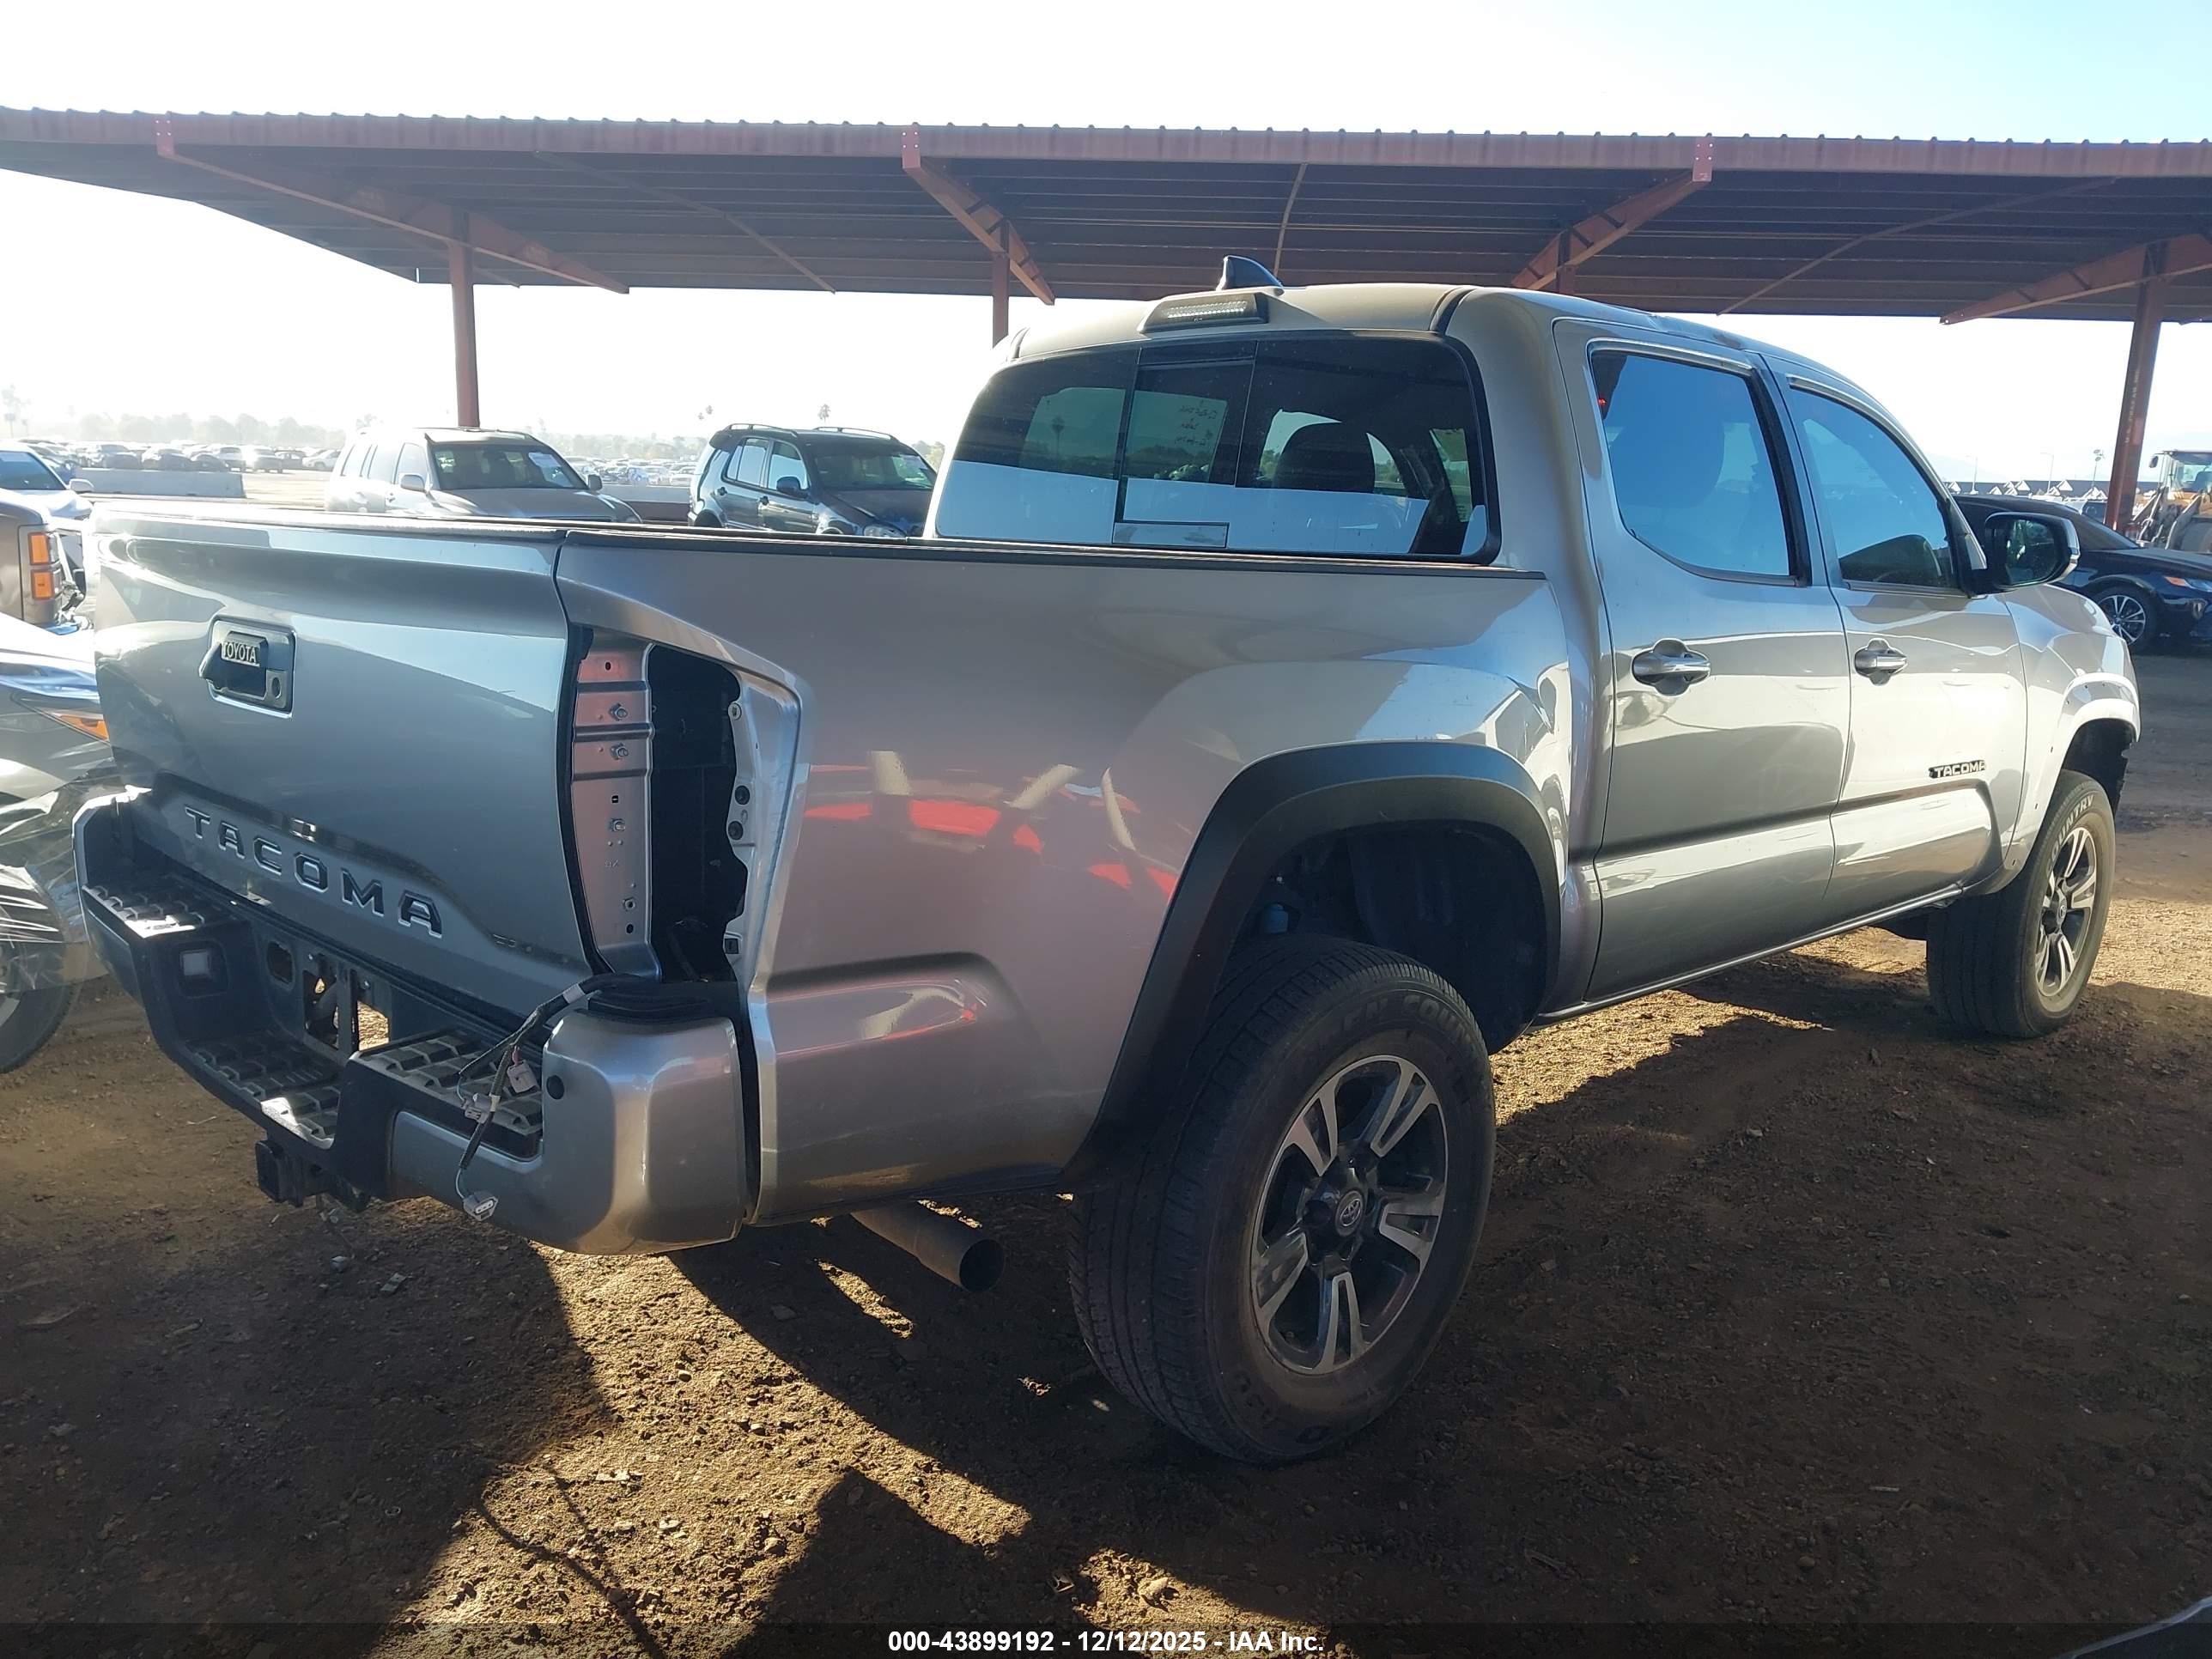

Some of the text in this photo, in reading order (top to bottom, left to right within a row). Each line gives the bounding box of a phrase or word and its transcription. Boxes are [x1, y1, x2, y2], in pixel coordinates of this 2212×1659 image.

[222, 641, 258, 664] TOYOTA
[1933, 760, 1986, 779] TACOMA
[2046, 794, 2094, 878] COUNTRY
[185, 805, 442, 939] TACOMA
